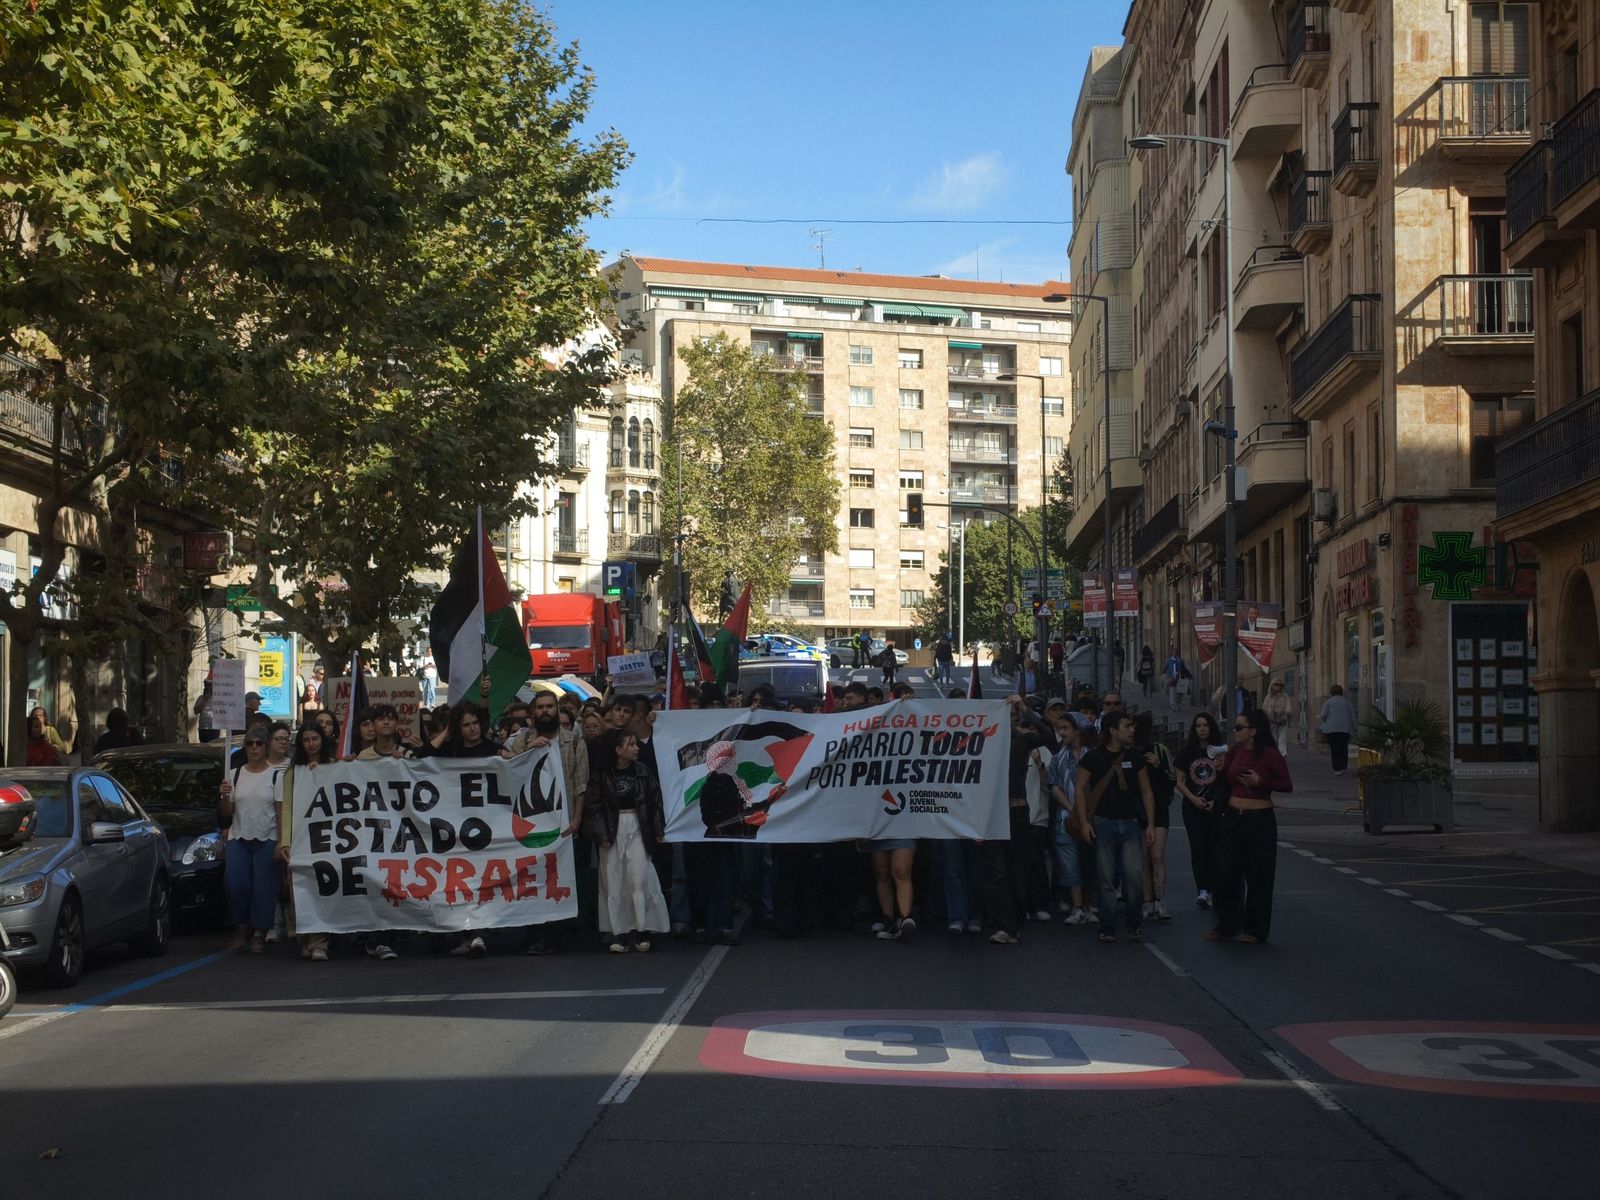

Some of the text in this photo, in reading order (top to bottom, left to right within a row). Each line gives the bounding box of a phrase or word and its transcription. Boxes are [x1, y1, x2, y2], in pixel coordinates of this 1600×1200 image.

[607, 565, 622, 586] P
[843, 714, 987, 735] HUELGA 15 OCT
[824, 730, 986, 763] PARARLO TODO
[805, 759, 982, 790] POR PALESTINA
[304, 773, 512, 818] ABAJO EL
[909, 790, 963, 799] COORDINADORA
[909, 798, 937, 806] JUVENIL
[909, 805, 948, 814] SOCIALISTA
[308, 817, 492, 855] ESTADO
[311, 852, 571, 905] DE ISRAEL
[843, 1024, 1093, 1068] 30
